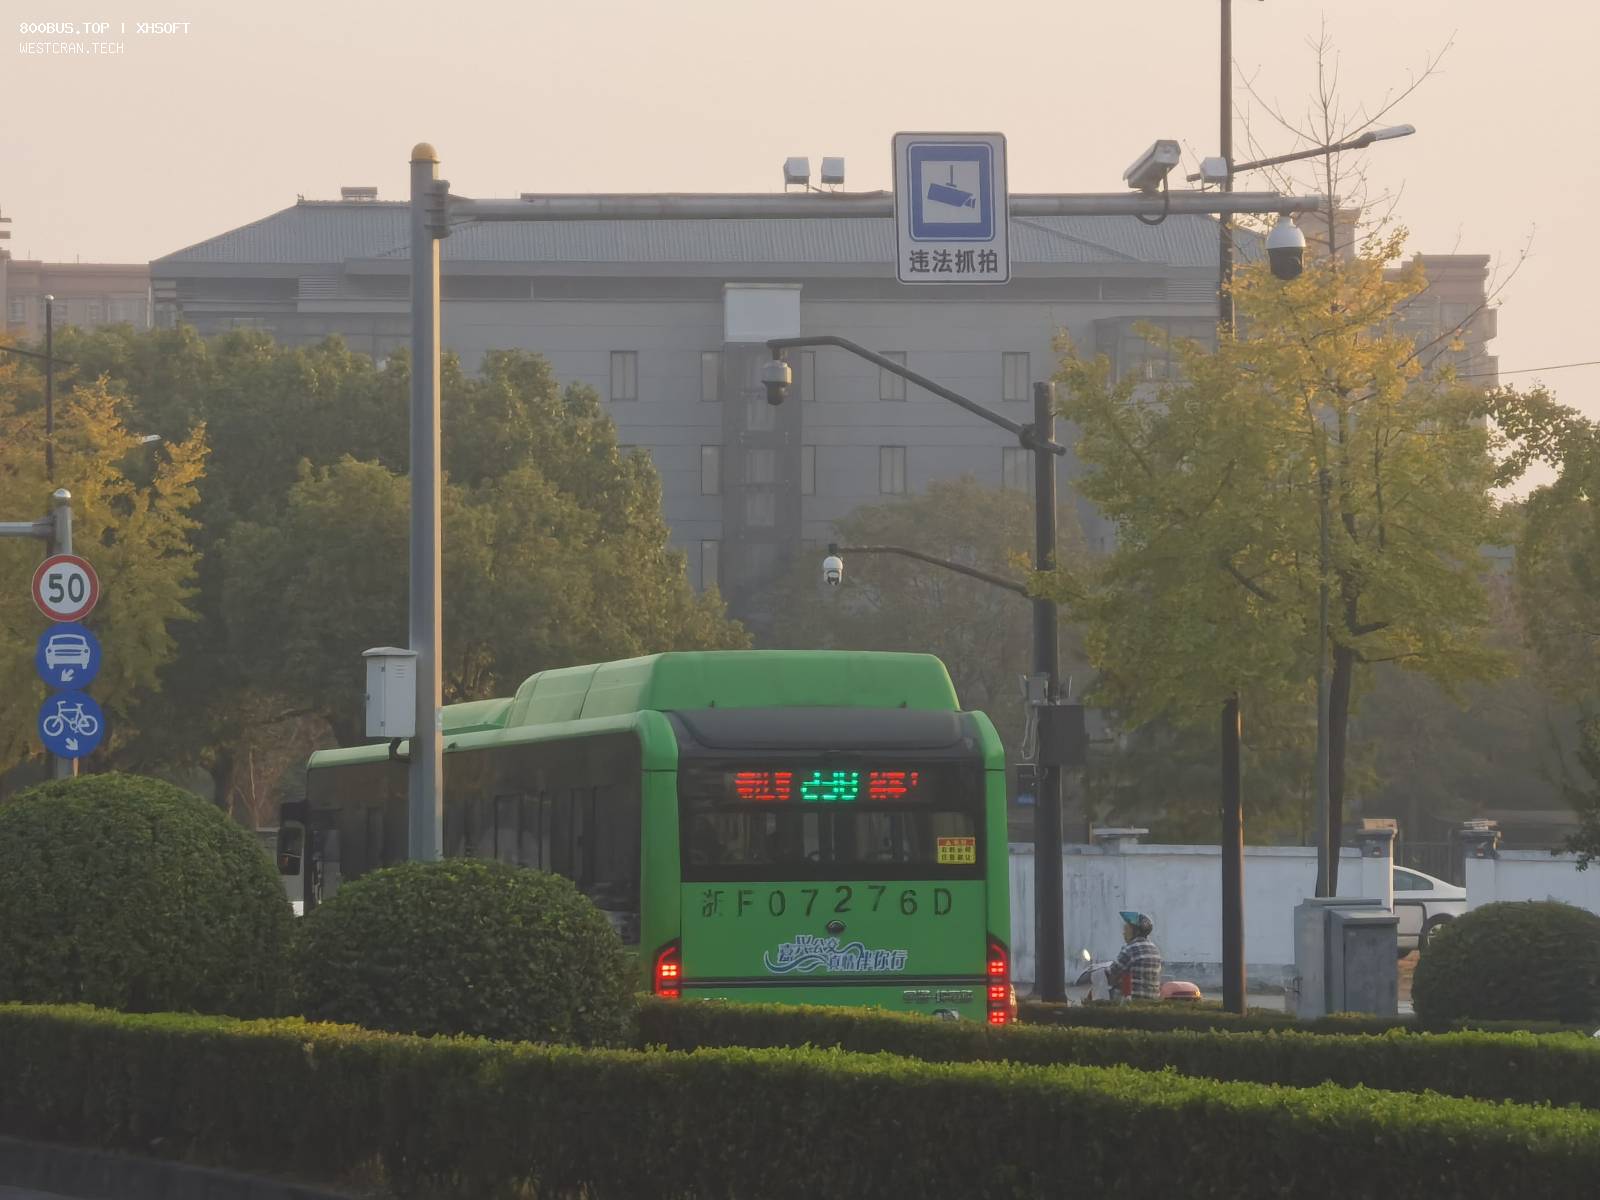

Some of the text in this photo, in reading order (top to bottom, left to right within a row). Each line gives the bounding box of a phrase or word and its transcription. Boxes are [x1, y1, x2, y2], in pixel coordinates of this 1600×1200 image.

[909, 249, 998, 273] 违法抓拍
[48, 573, 85, 603] 50
